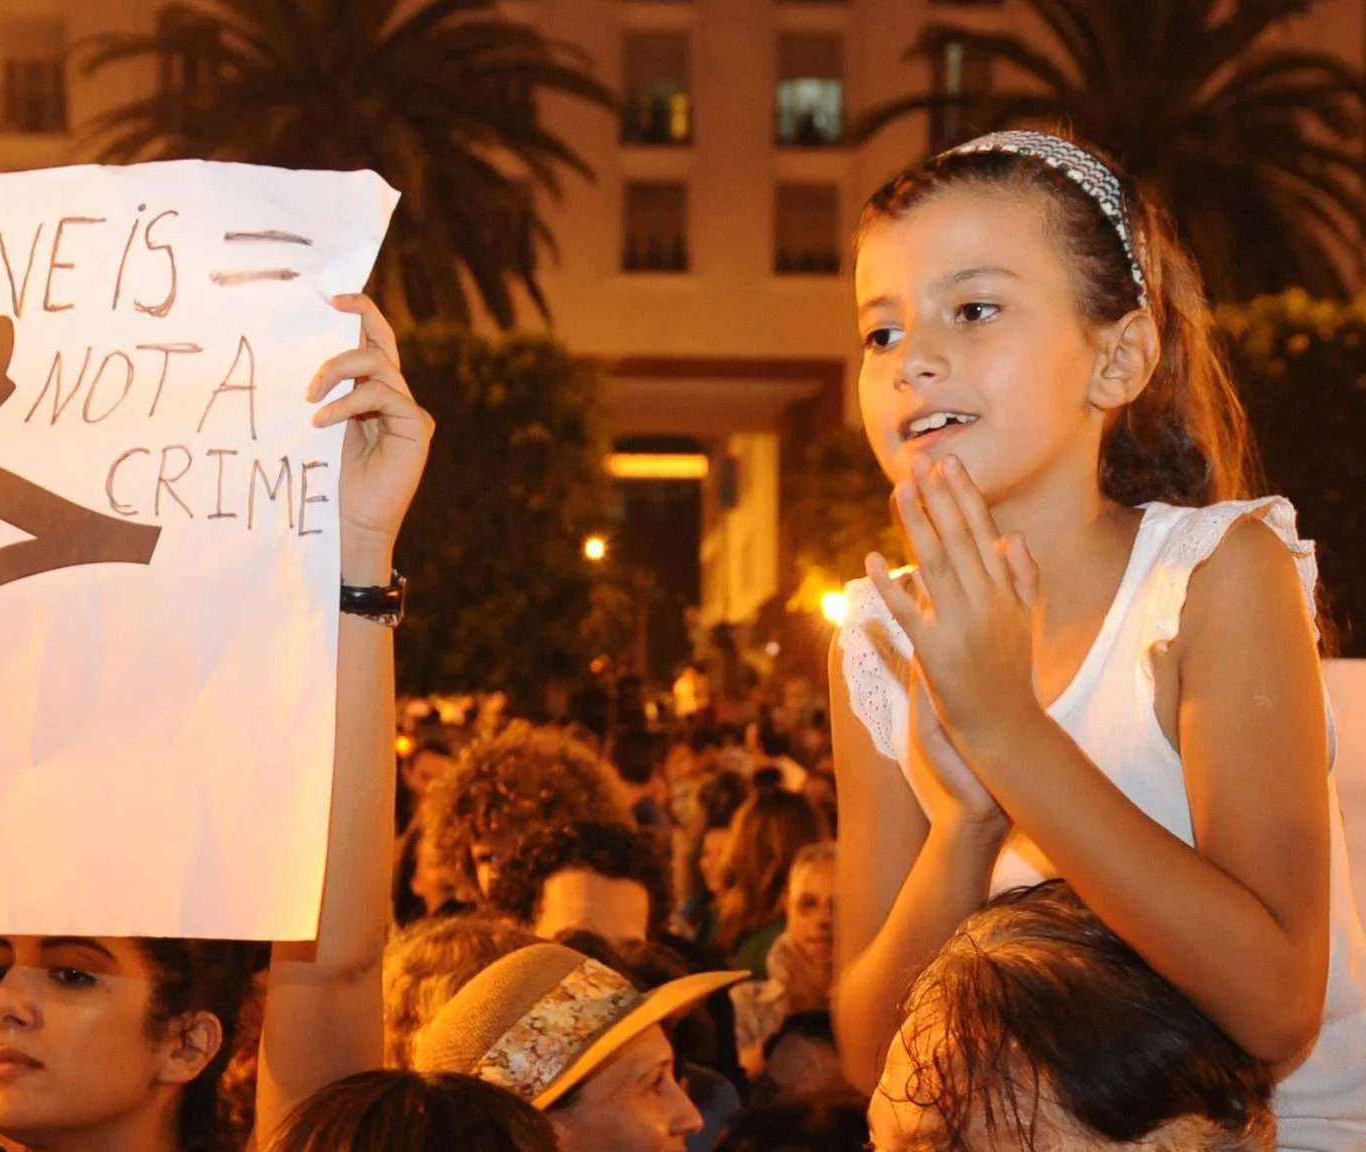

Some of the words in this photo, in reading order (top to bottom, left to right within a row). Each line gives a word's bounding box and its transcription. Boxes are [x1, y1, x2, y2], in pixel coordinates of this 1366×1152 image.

[24, 343, 203, 427] NOT
[196, 335, 258, 441] A
[104, 444, 329, 537] CRIME
